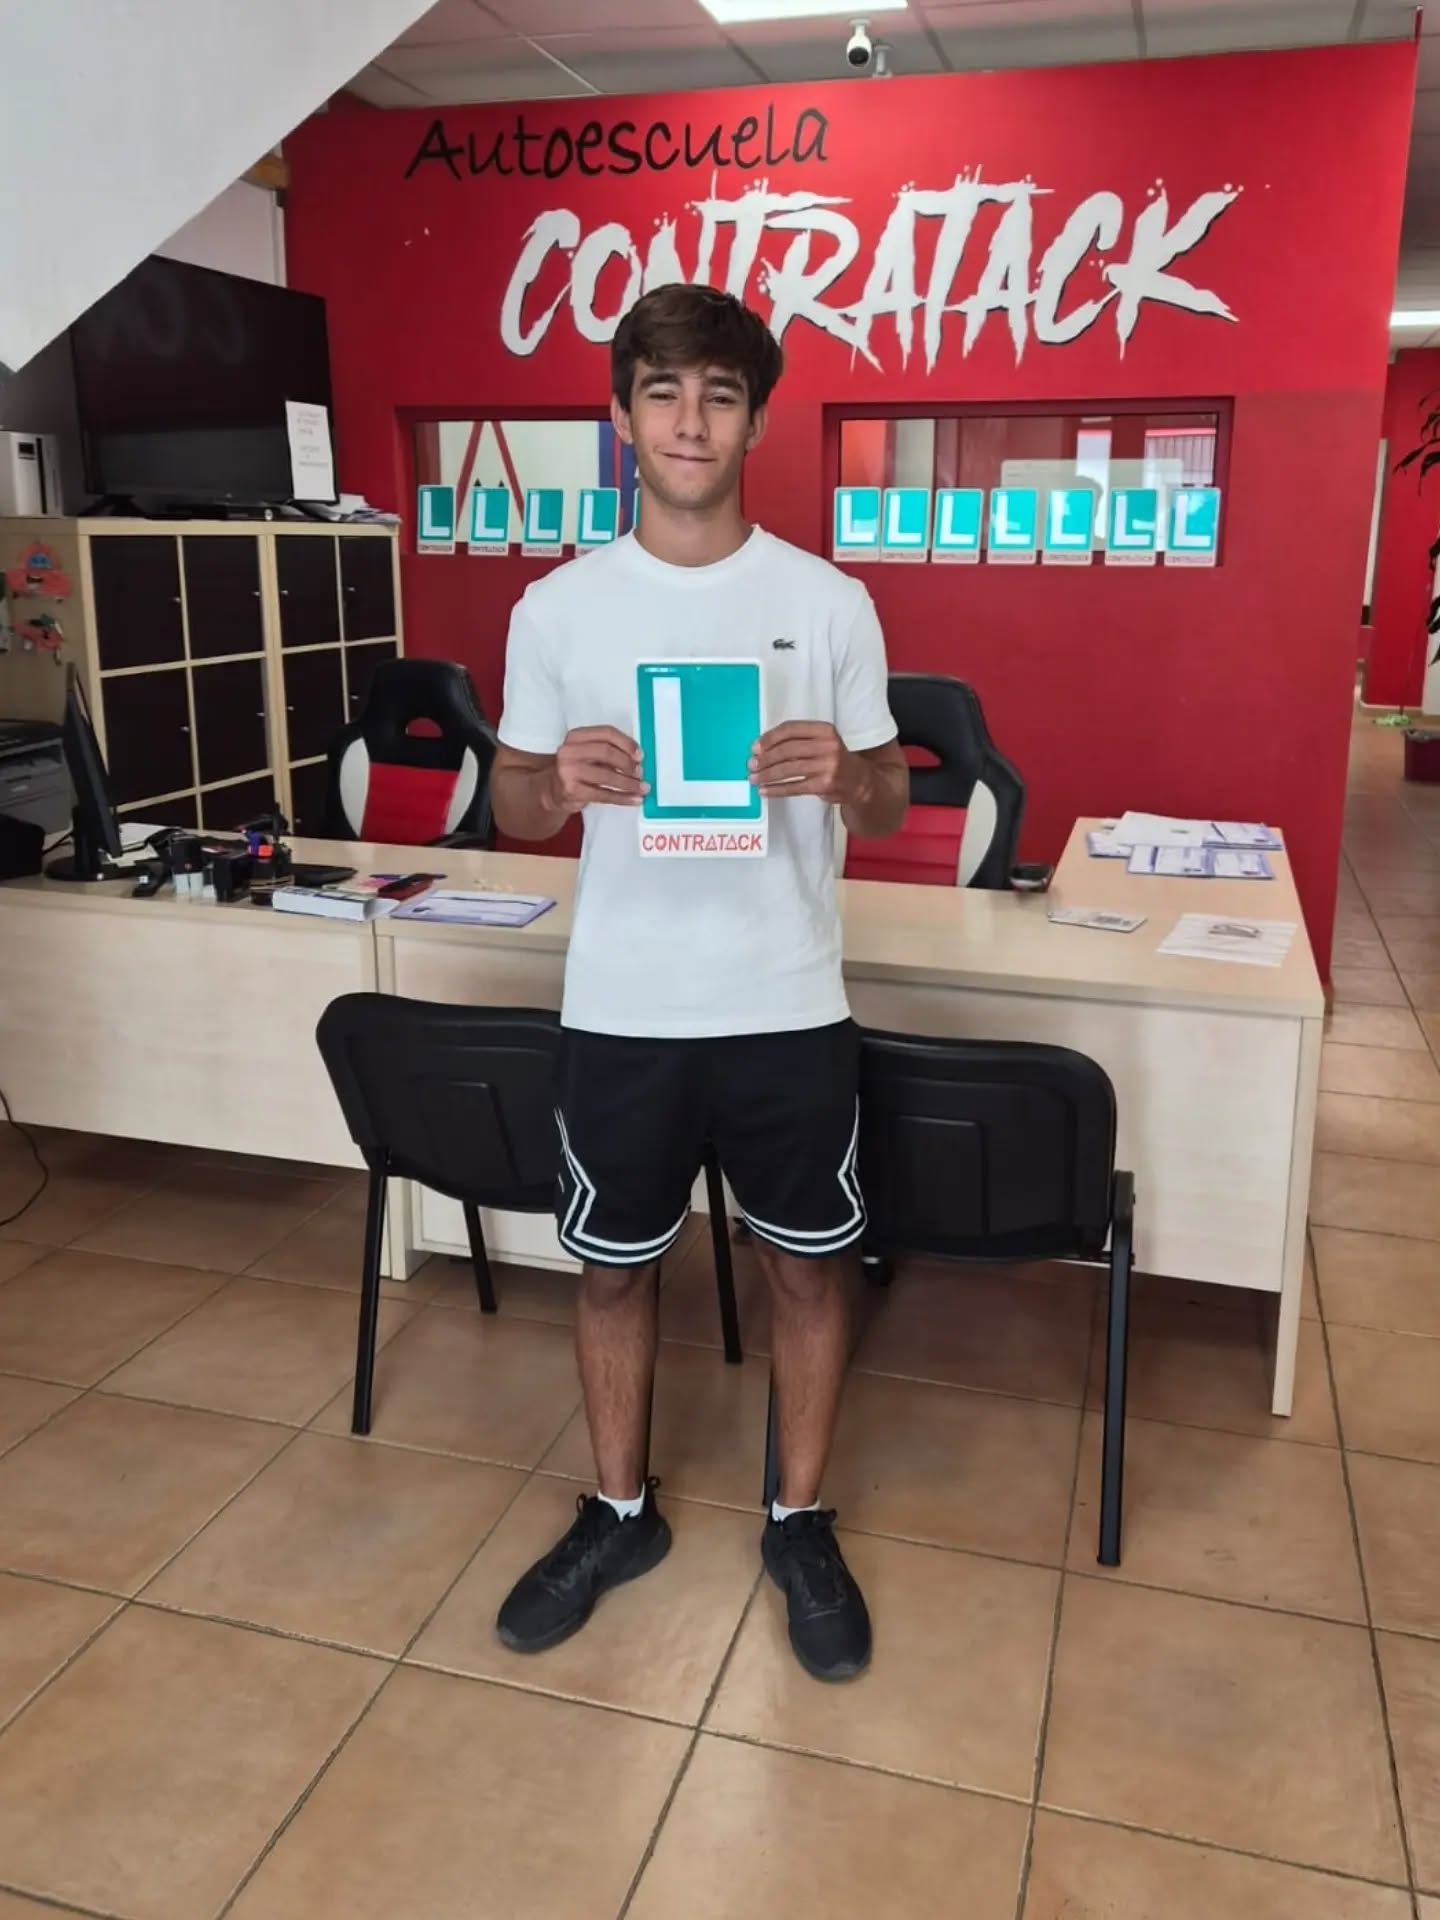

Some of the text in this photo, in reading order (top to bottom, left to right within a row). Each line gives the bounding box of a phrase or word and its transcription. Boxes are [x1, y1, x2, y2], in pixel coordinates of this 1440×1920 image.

[406, 103, 829, 180] Autoescuela
[500, 166, 1240, 374] CONTRATACK
[422, 491, 450, 537] L
[475, 493, 505, 538] L
[528, 493, 558, 539] L
[582, 494, 612, 540] L
[841, 494, 875, 543] L
[887, 494, 922, 544] L
[939, 495, 975, 545] L
[995, 494, 1031, 545] L
[1050, 493, 1087, 545] L
[1113, 495, 1151, 546] L
[1173, 494, 1211, 547] L
[652, 677, 750, 807] L
[642, 834, 763, 851] CONTRATACK
